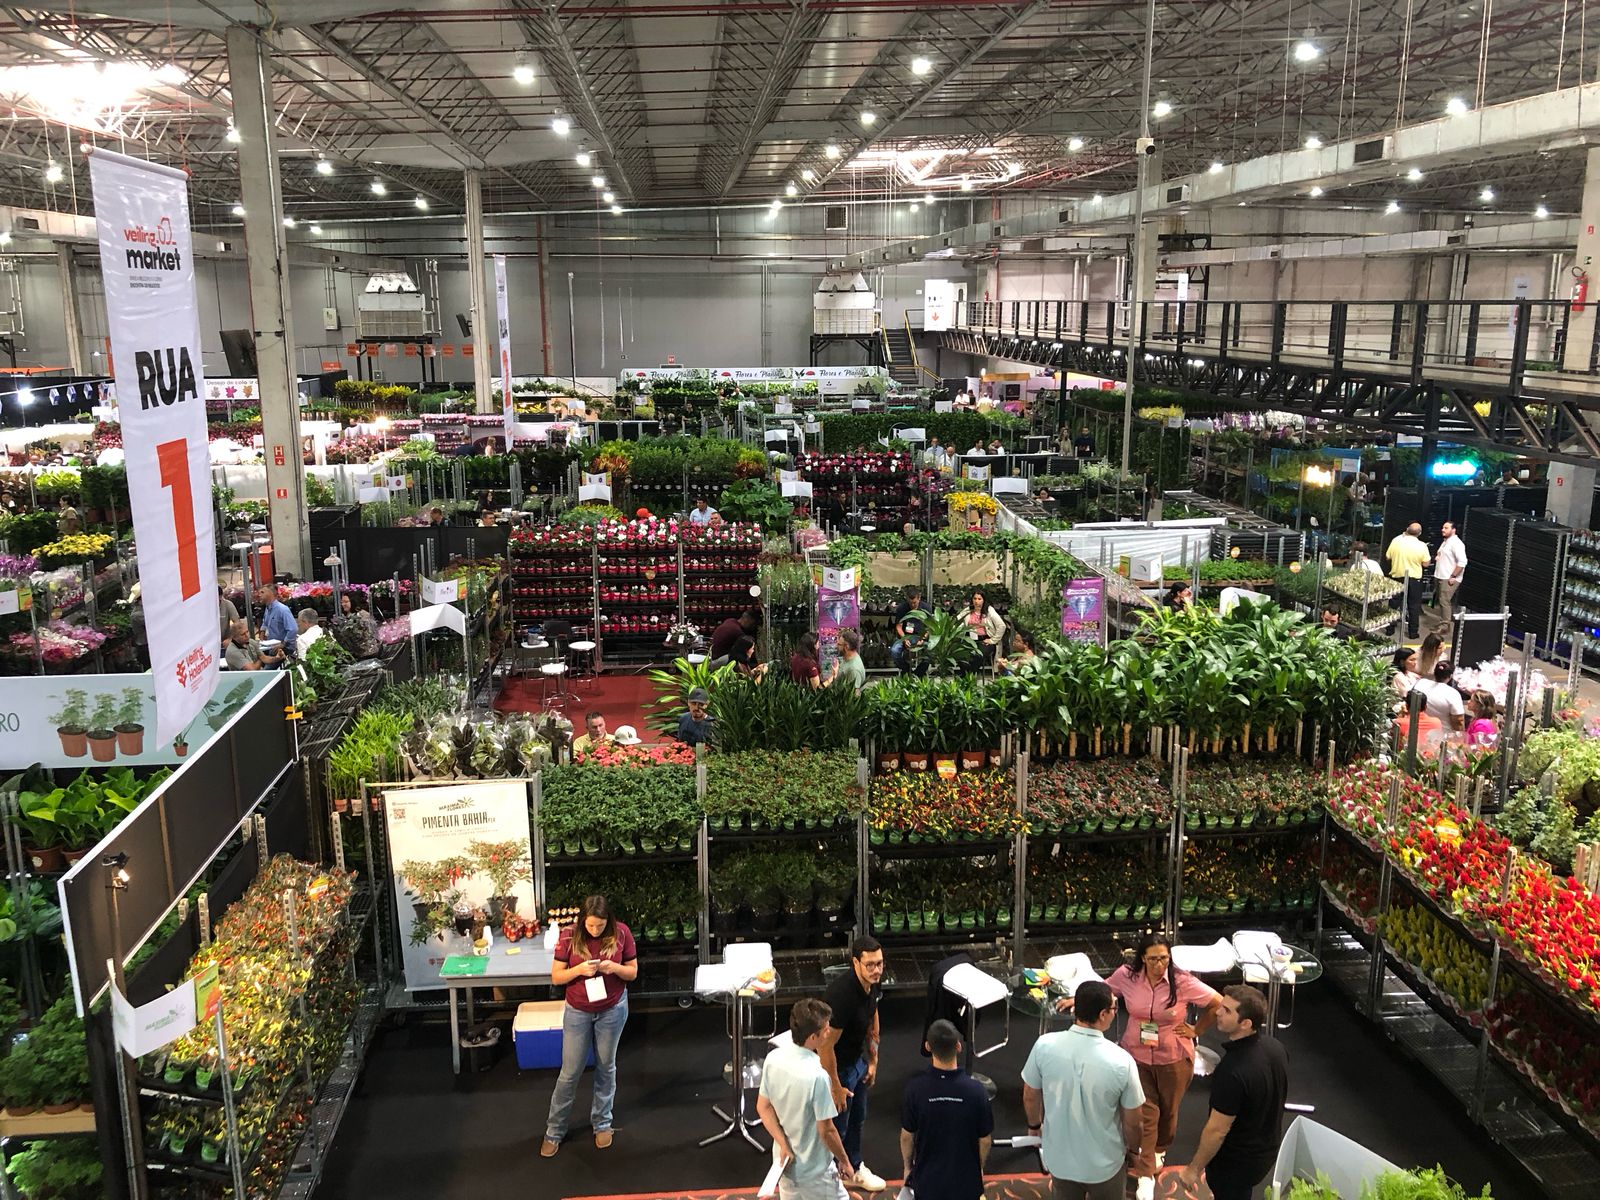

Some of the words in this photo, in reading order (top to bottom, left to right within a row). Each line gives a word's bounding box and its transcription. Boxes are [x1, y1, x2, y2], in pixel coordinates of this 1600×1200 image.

[126, 246, 181, 271] market
[135, 347, 198, 411] RUA
[275, 447, 283, 456] H
[156, 438, 201, 602] 1
[421, 814, 460, 830] PIMENTA
[462, 811, 488, 826] BAHIA
